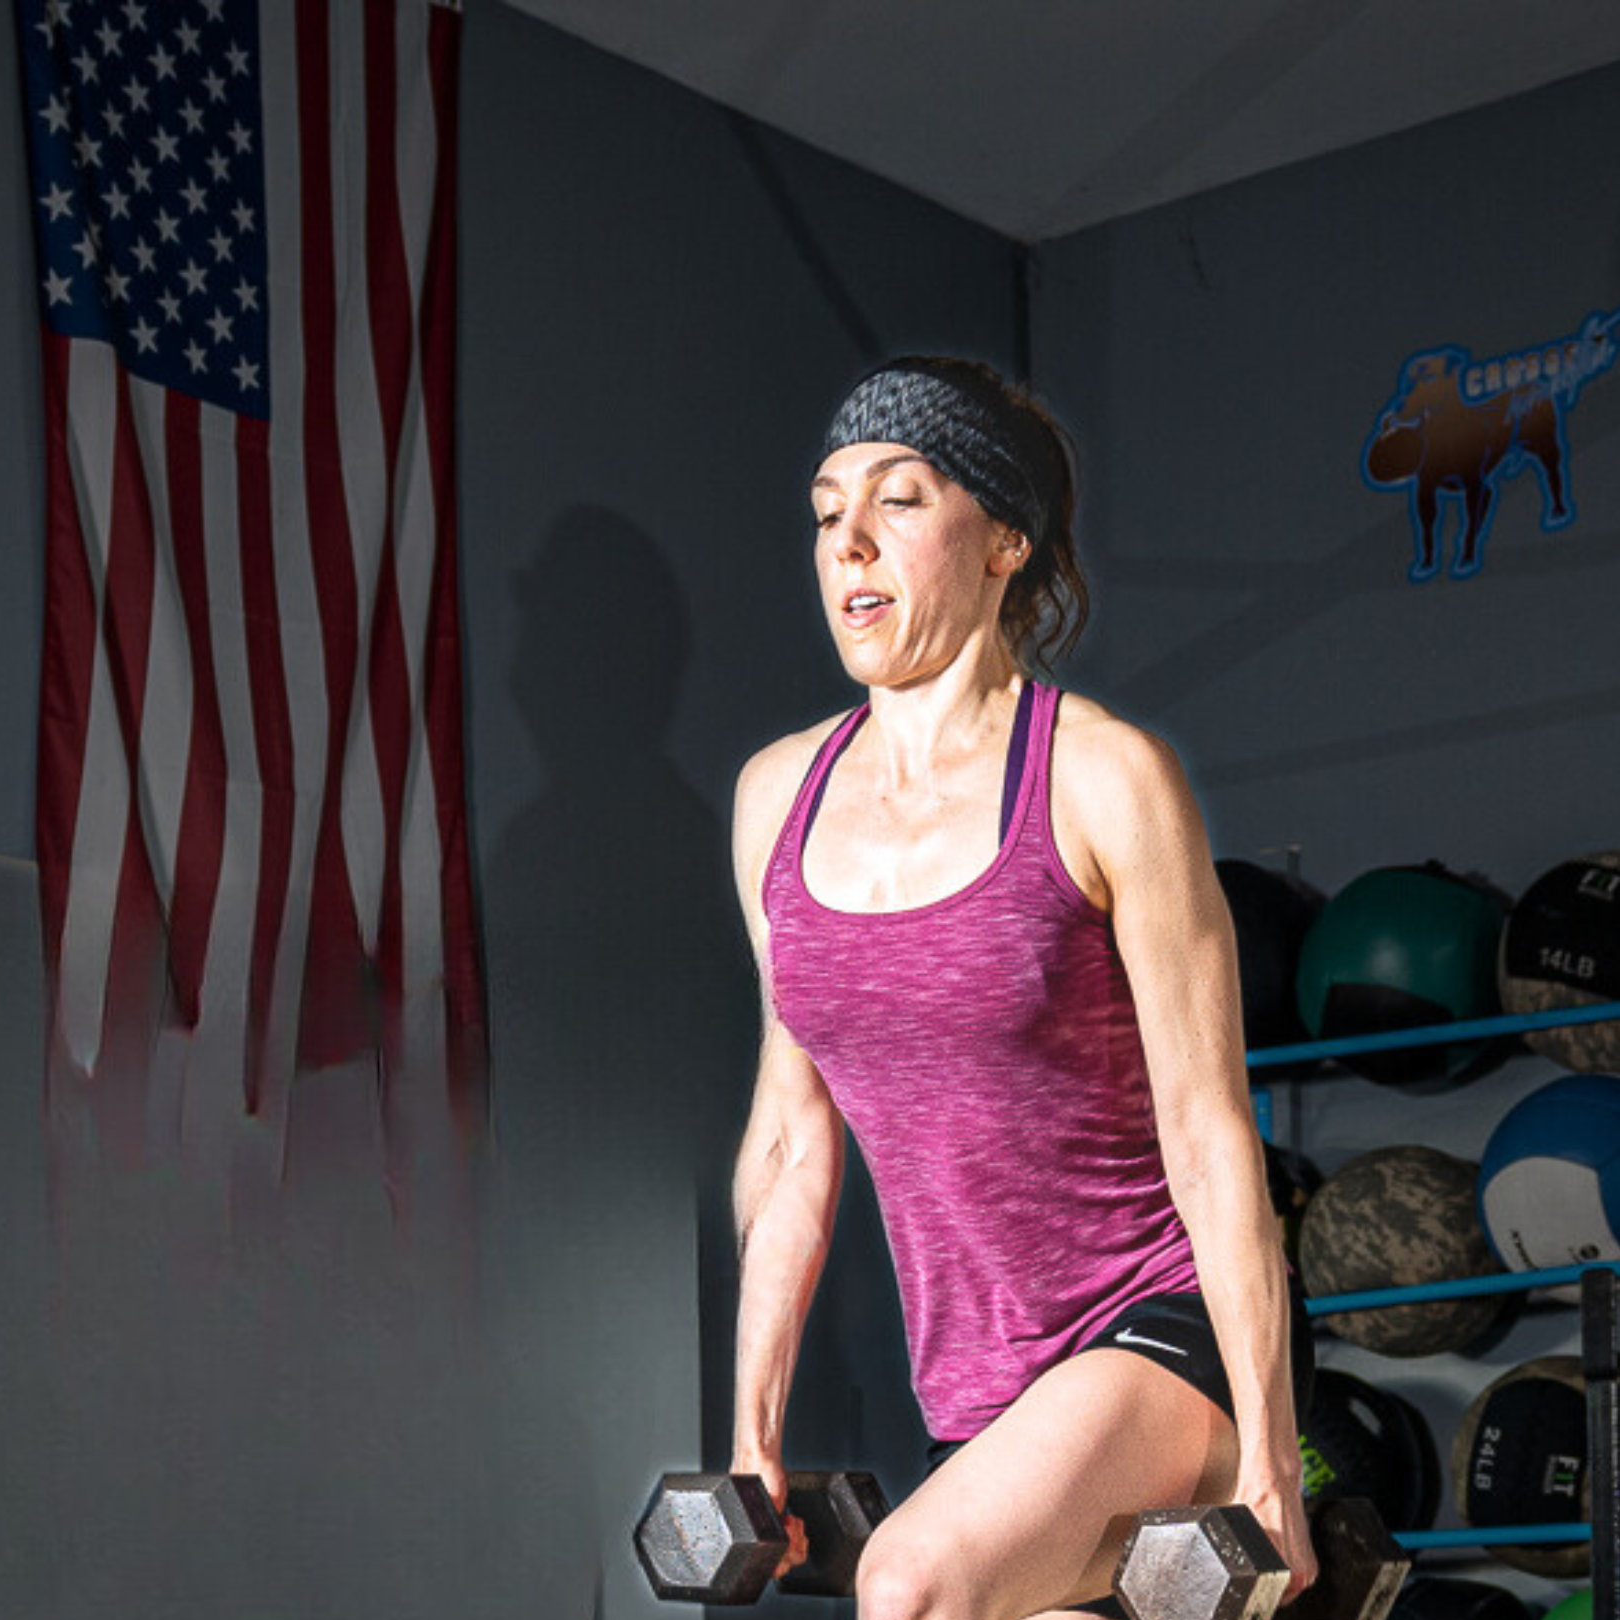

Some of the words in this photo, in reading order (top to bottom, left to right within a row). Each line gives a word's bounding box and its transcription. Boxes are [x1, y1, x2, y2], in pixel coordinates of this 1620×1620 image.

[1539, 946, 1597, 979] 14LB
[1474, 1425, 1502, 1491] 24LB
[1552, 1454, 1582, 1499] FIT
